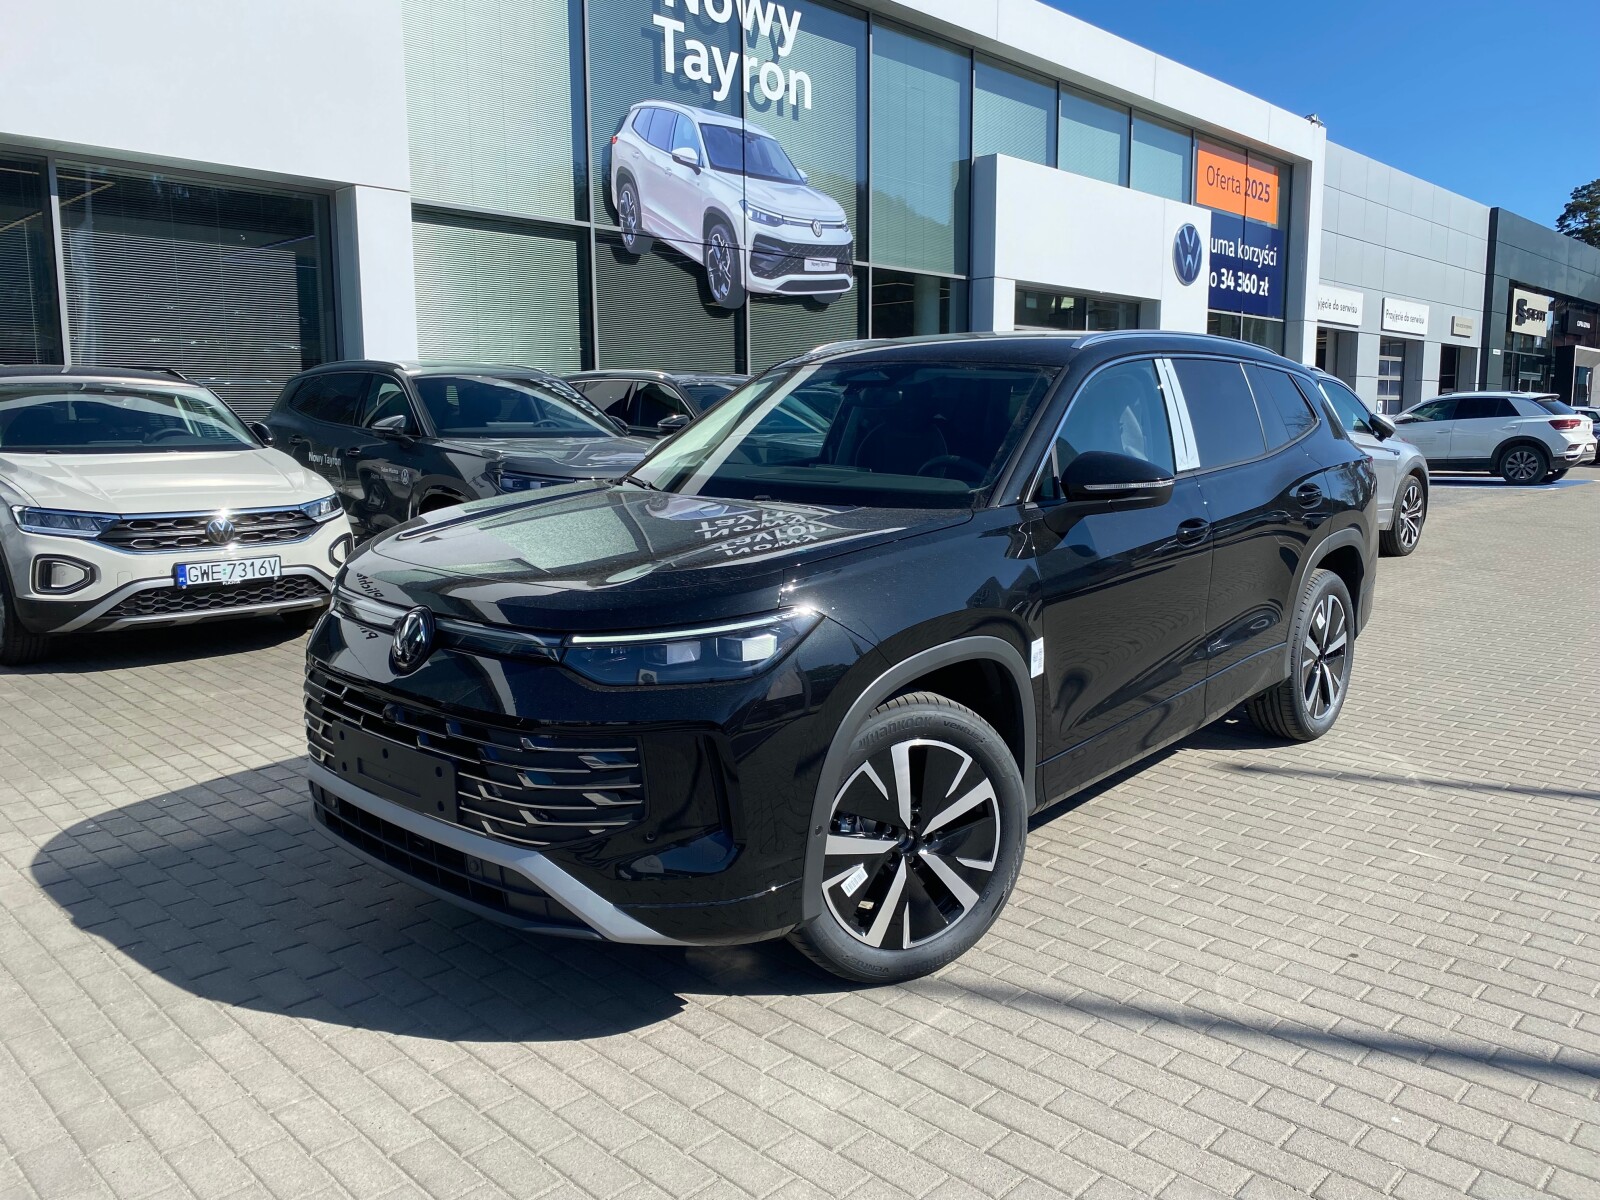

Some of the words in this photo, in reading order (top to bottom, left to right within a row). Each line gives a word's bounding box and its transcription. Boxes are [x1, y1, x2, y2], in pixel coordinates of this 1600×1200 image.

[665, 0, 802, 57] owy
[653, 14, 812, 110] Tayron
[1206, 165, 1241, 195] Oferta
[1245, 177, 1270, 203] 2025
[1237, 237, 1277, 268] korzyści
[1219, 267, 1235, 290] 34
[1236, 271, 1258, 294] 360
[1258, 276, 1269, 297] zł
[1333, 299, 1340, 311] do
[1340, 302, 1358, 314] serwisu
[308, 451, 324, 466] Nowy
[324, 453, 342, 468] Tayron
[188, 564, 222, 583] GWE
[227, 559, 277, 580] 7316V
